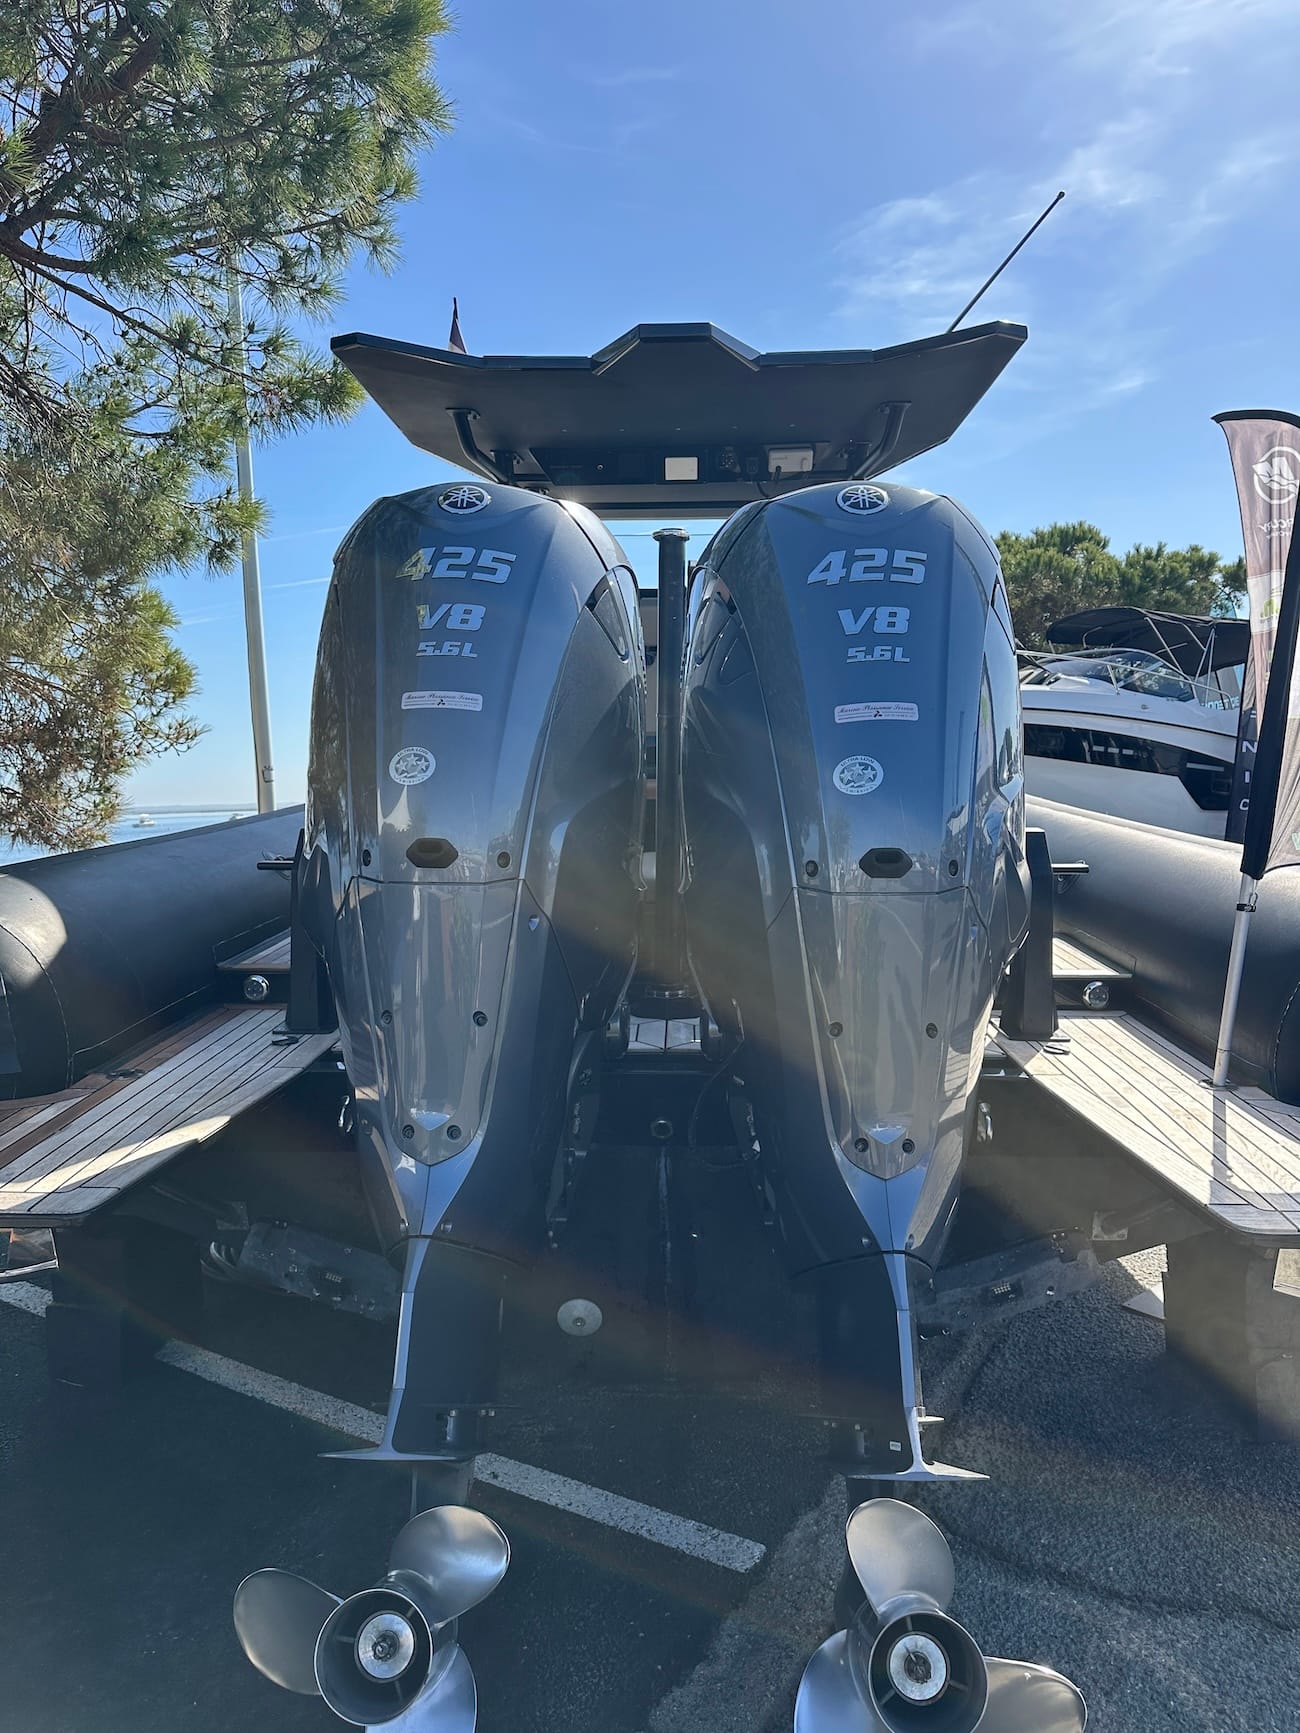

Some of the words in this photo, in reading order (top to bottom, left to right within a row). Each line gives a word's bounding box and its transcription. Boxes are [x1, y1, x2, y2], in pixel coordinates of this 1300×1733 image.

[396, 546, 517, 584] 425
[807, 548, 928, 586] 425
[416, 603, 487, 631] V8
[837, 606, 911, 635] V8
[416, 641, 478, 658] 5.6L
[846, 645, 911, 663] 5.6L
